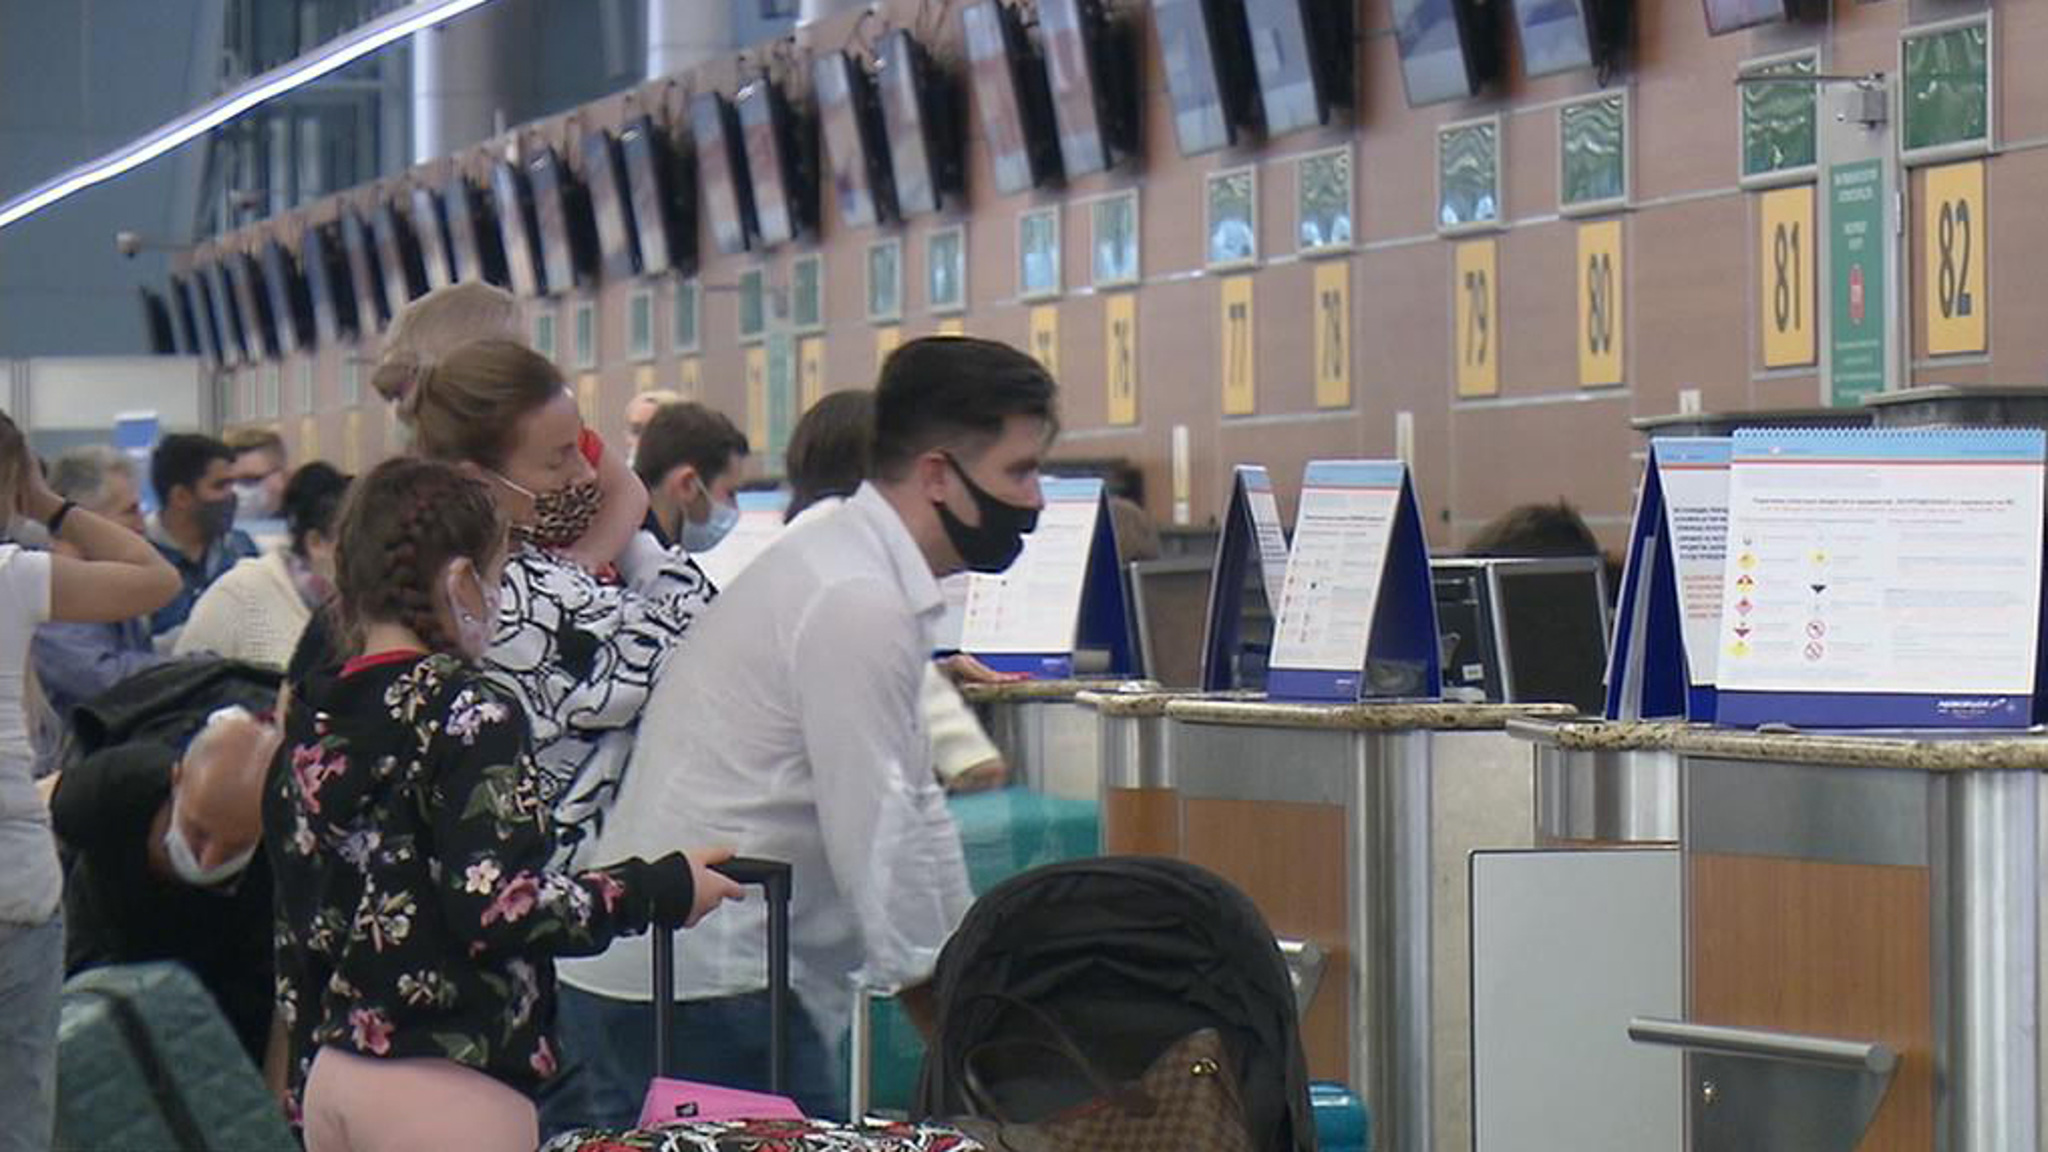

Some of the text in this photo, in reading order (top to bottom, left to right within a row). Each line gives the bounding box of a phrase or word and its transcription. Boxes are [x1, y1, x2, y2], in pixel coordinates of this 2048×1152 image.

[1588, 253, 1613, 354] 80
[1775, 221, 1800, 332] 81
[1939, 198, 1972, 318] 82
[1229, 303, 1247, 386] 77
[1323, 291, 1342, 380] 78
[1466, 270, 1488, 366] 79
